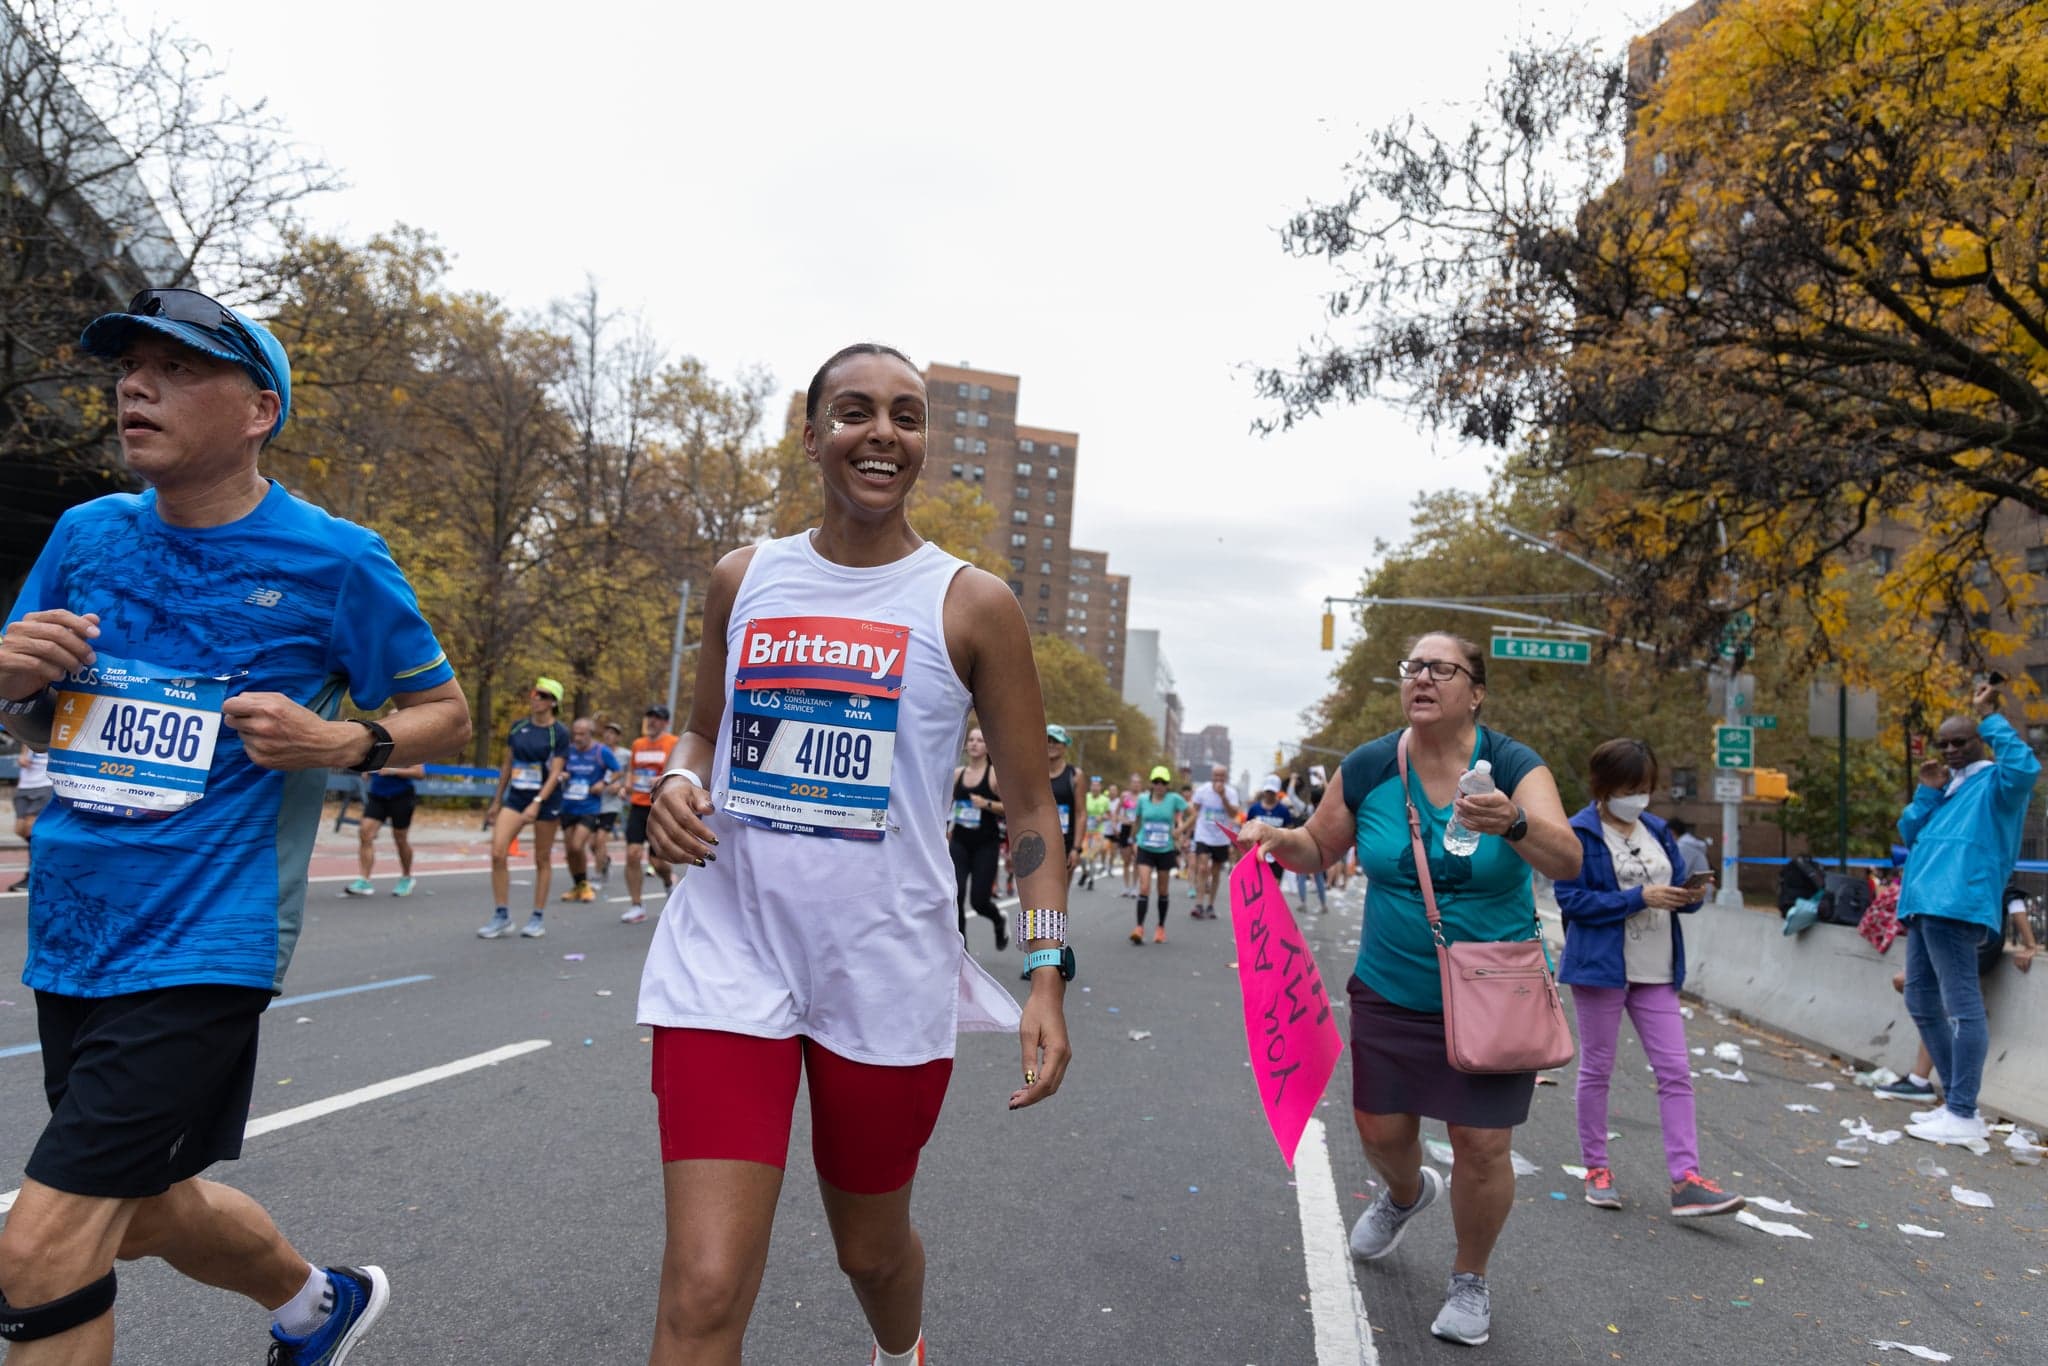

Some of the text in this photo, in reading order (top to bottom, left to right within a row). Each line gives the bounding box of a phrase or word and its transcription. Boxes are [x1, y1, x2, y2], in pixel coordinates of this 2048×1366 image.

[748, 630, 900, 680] Brittany
[1506, 641, 1517, 655] E
[1521, 642, 1551, 657] 124
[100, 673, 151, 685] CONSULTANCY
[163, 687, 197, 701] TATA
[786, 688, 806, 697] TATA
[63, 698, 75, 715] 4
[783, 703, 815, 714] SERVICES
[784, 695, 833, 708] CONSULTANCY
[844, 709, 873, 721] TATA
[57, 724, 71, 741] E
[101, 704, 203, 762] 48596
[749, 721, 760, 737] 4
[747, 746, 759, 762] B
[795, 728, 872, 780] 41189
[98, 762, 136, 778] 2022
[128, 787, 155, 798] move
[789, 783, 829, 799] 2022
[731, 795, 802, 814] #TCSNYCMarathon
[824, 808, 847, 817] move
[776, 822, 793, 831] FERRY
[1240, 862, 1273, 973] ARE
[1280, 939, 1308, 1024] MY
